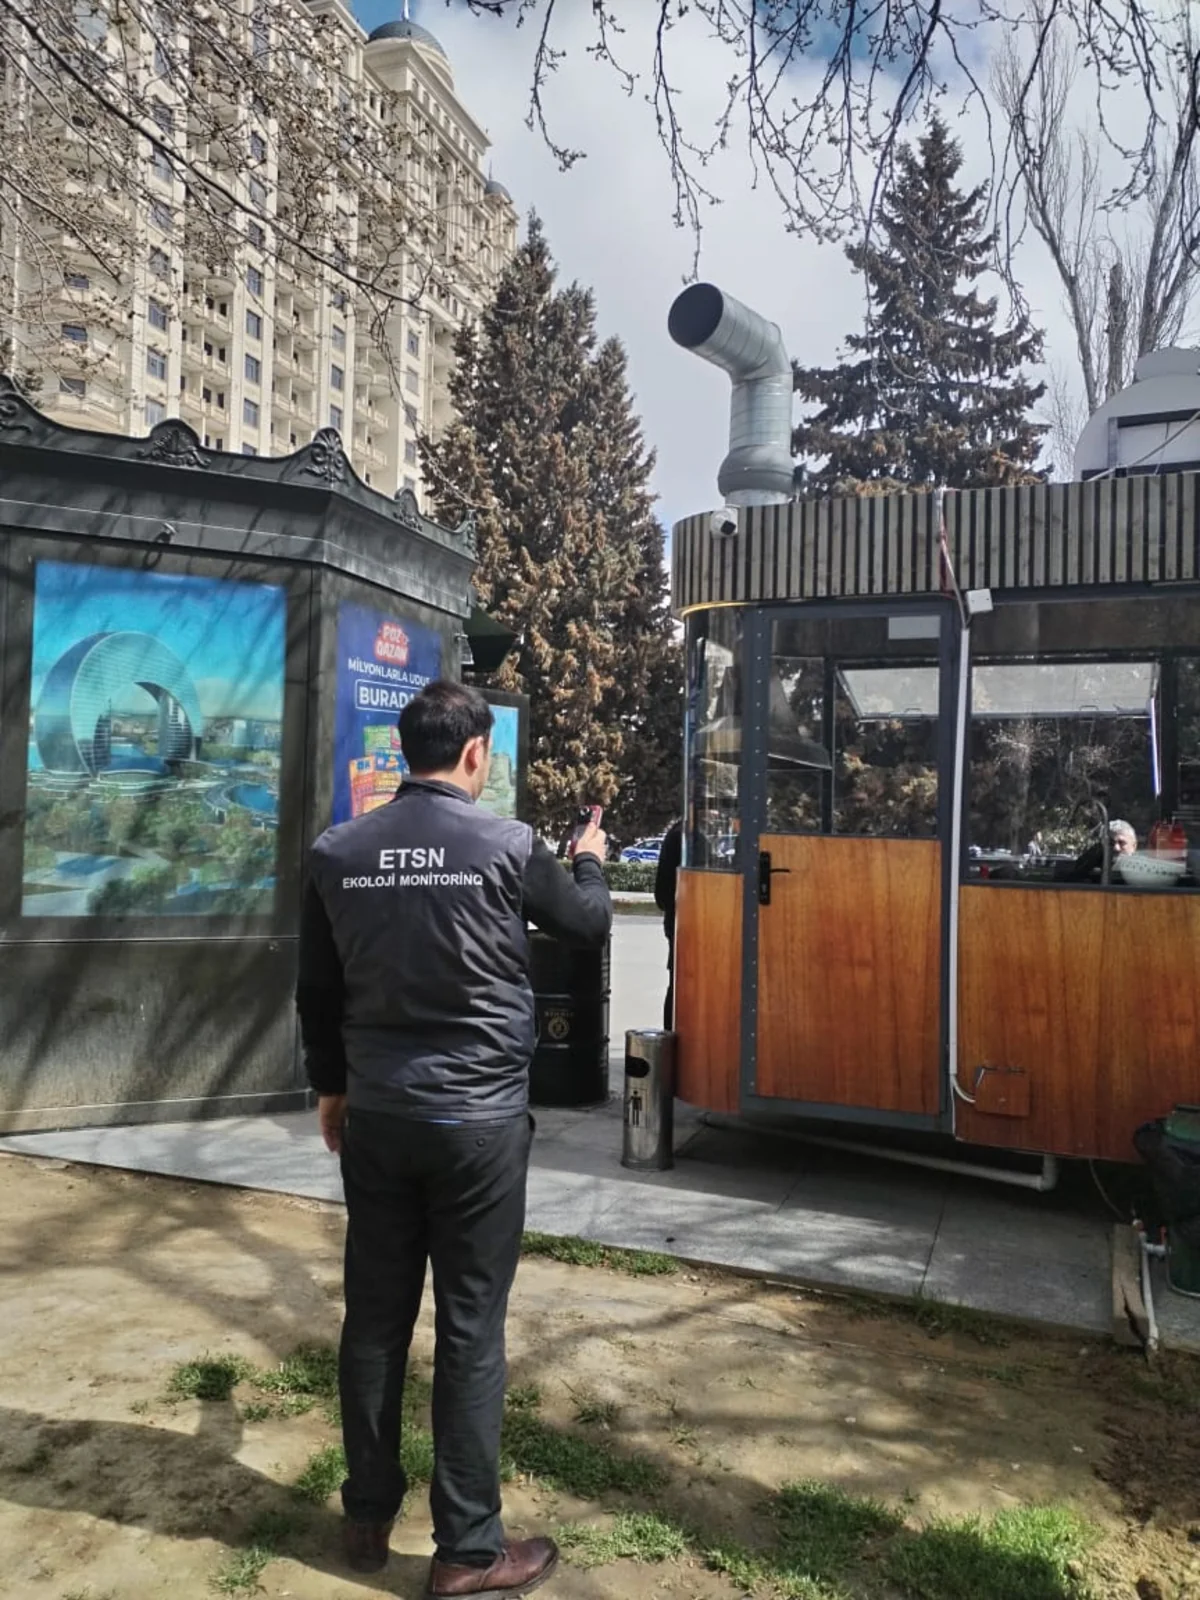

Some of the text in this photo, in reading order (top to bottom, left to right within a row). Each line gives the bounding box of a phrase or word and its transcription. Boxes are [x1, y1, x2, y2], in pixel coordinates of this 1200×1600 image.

[348, 657, 408, 682] MİLYONLARLA
[379, 847, 445, 869] ETSN
[342, 871, 484, 889] EKOLOJİ MONİTORİNQ
